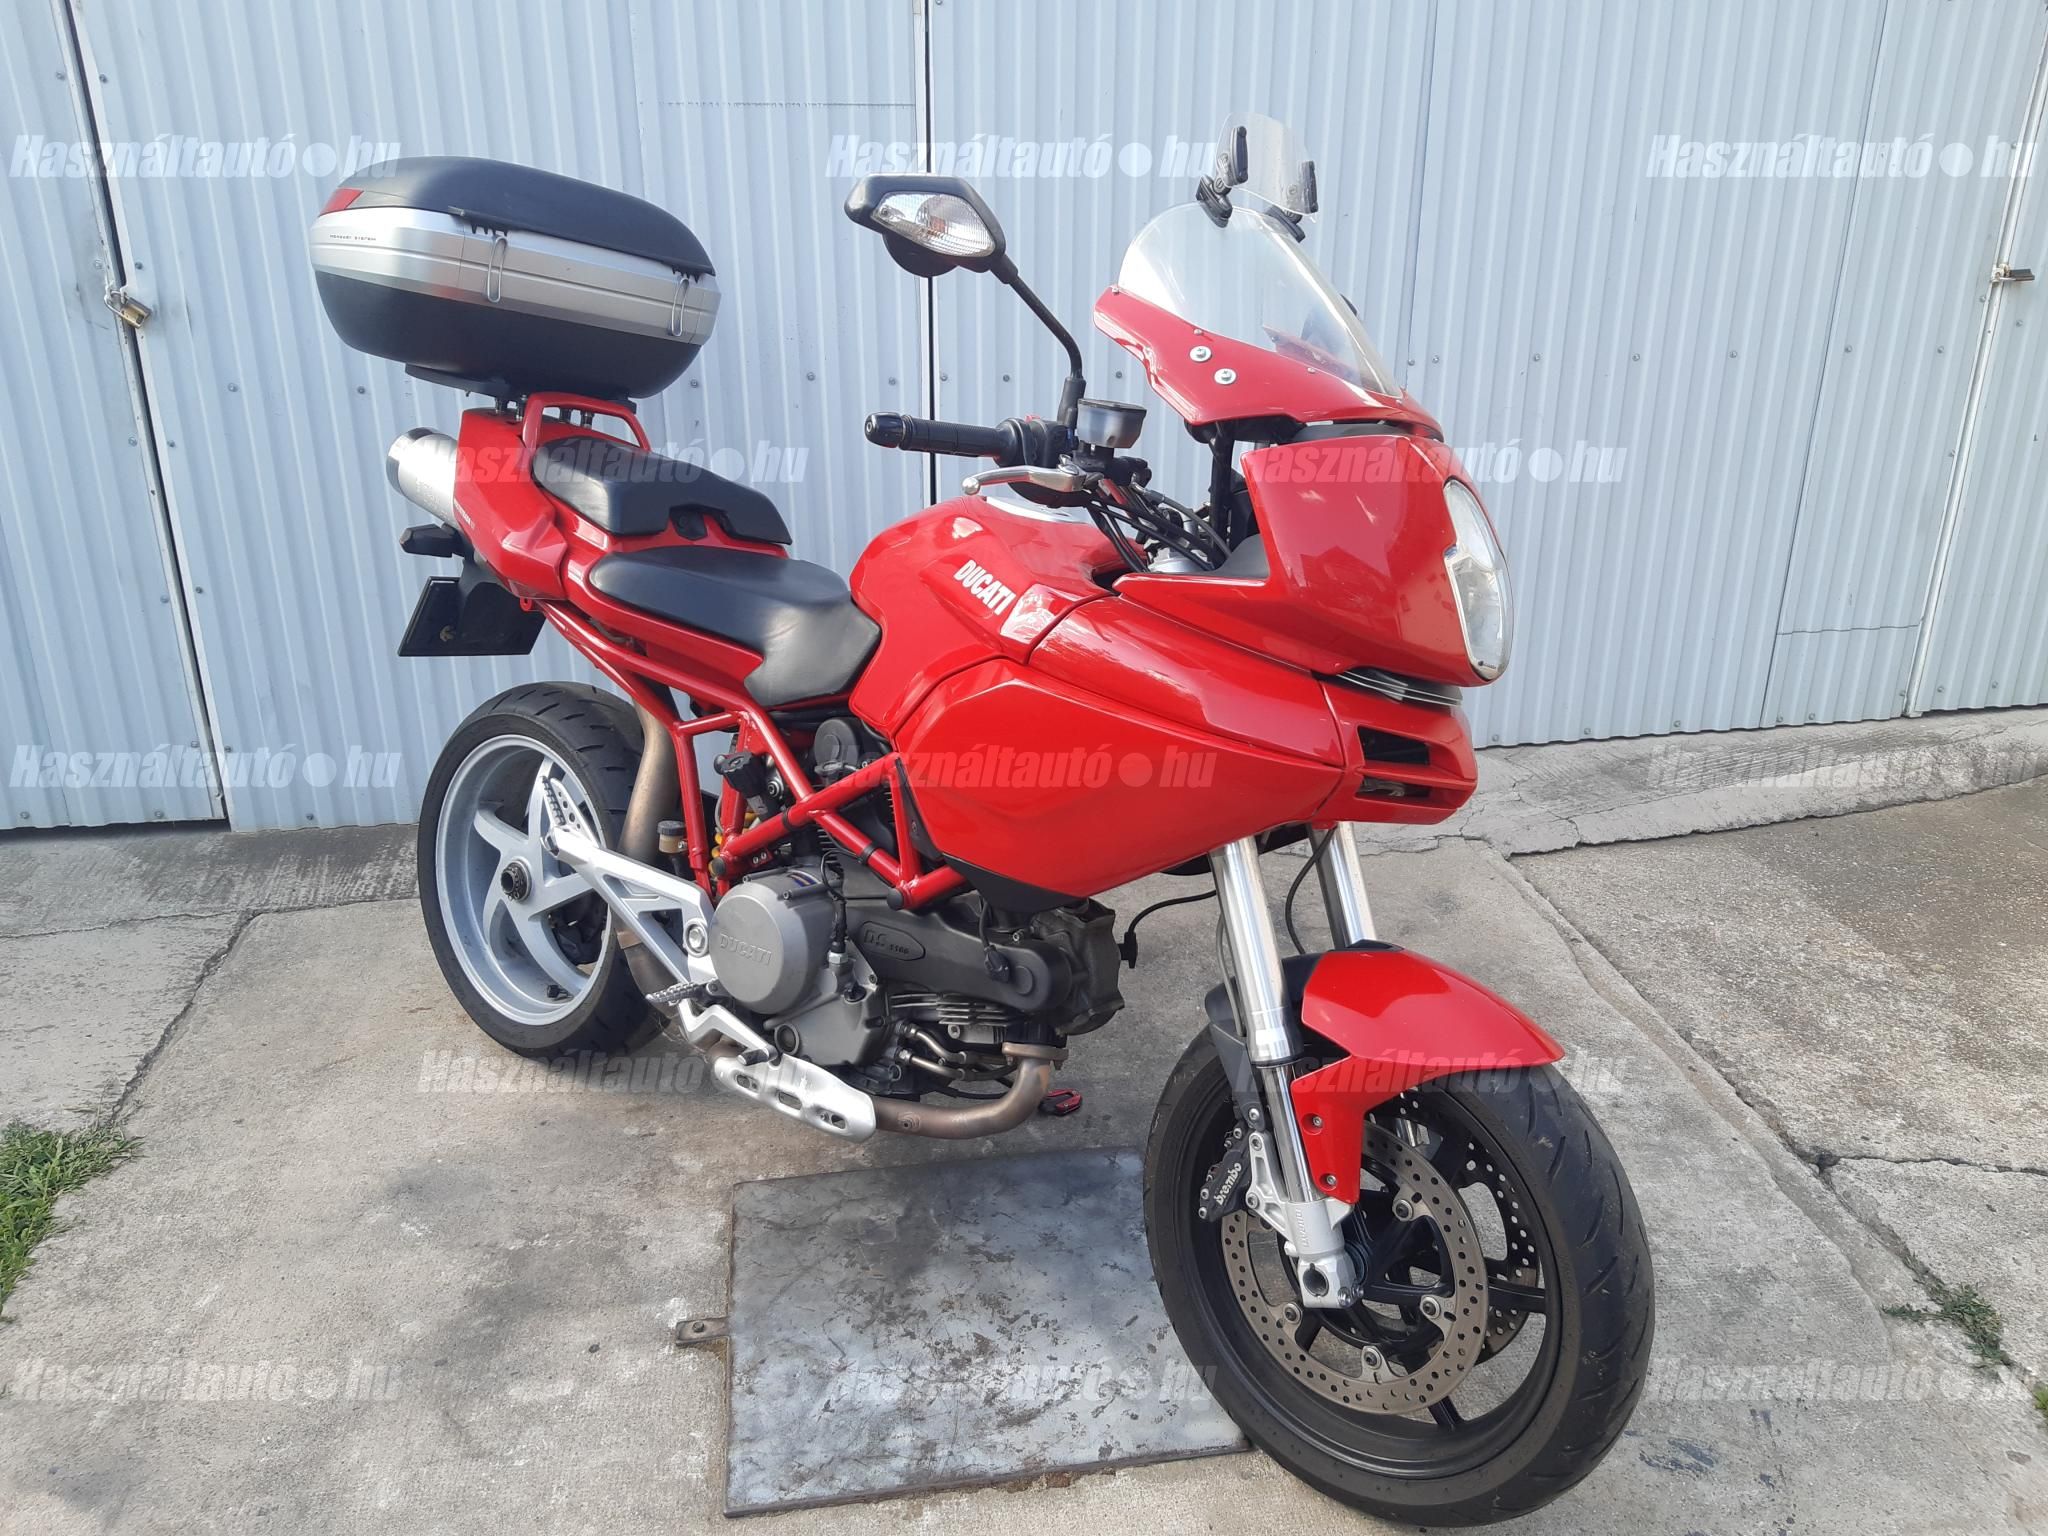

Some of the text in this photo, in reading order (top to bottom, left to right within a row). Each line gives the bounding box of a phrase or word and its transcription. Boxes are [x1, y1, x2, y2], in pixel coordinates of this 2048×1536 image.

[953, 559, 1017, 616] DUCATI
[719, 932, 772, 967] DUCATI
[1214, 1162, 1242, 1206] brembo
